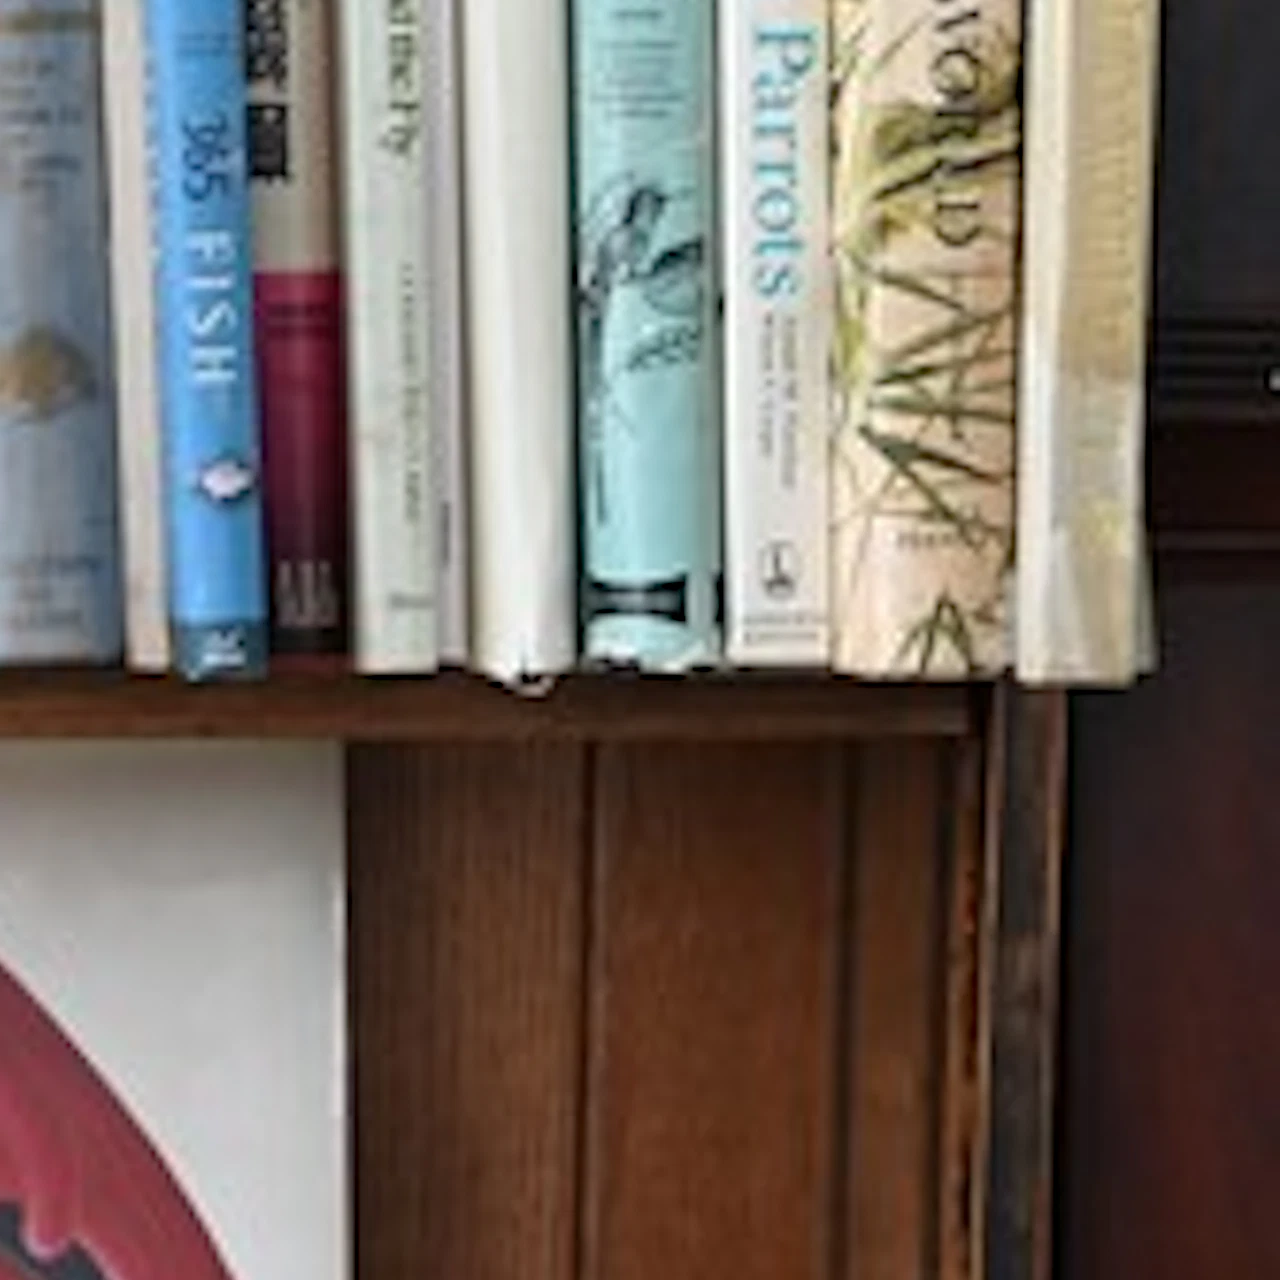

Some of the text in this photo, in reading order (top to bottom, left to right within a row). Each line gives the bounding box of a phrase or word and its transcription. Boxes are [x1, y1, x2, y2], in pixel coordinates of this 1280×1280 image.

[387, 33, 421, 92] the
[750, 26, 824, 300] Parrots
[182, 113, 241, 386] 365 FISH
